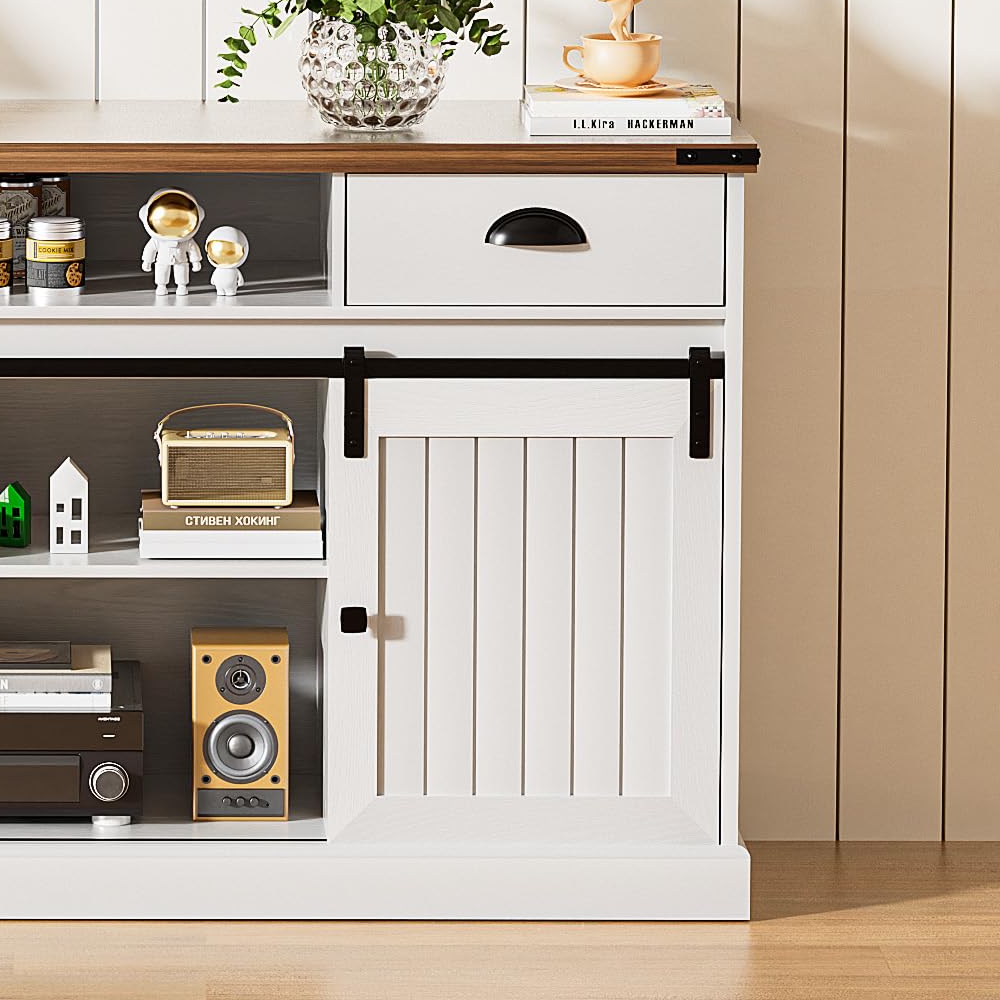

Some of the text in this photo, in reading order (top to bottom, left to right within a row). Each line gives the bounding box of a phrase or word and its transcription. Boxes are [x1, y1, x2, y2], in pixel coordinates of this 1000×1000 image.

[627, 119, 694, 129] HACKERMAN
[185, 515, 281, 526] СТИВЕН ХОКИНГ
